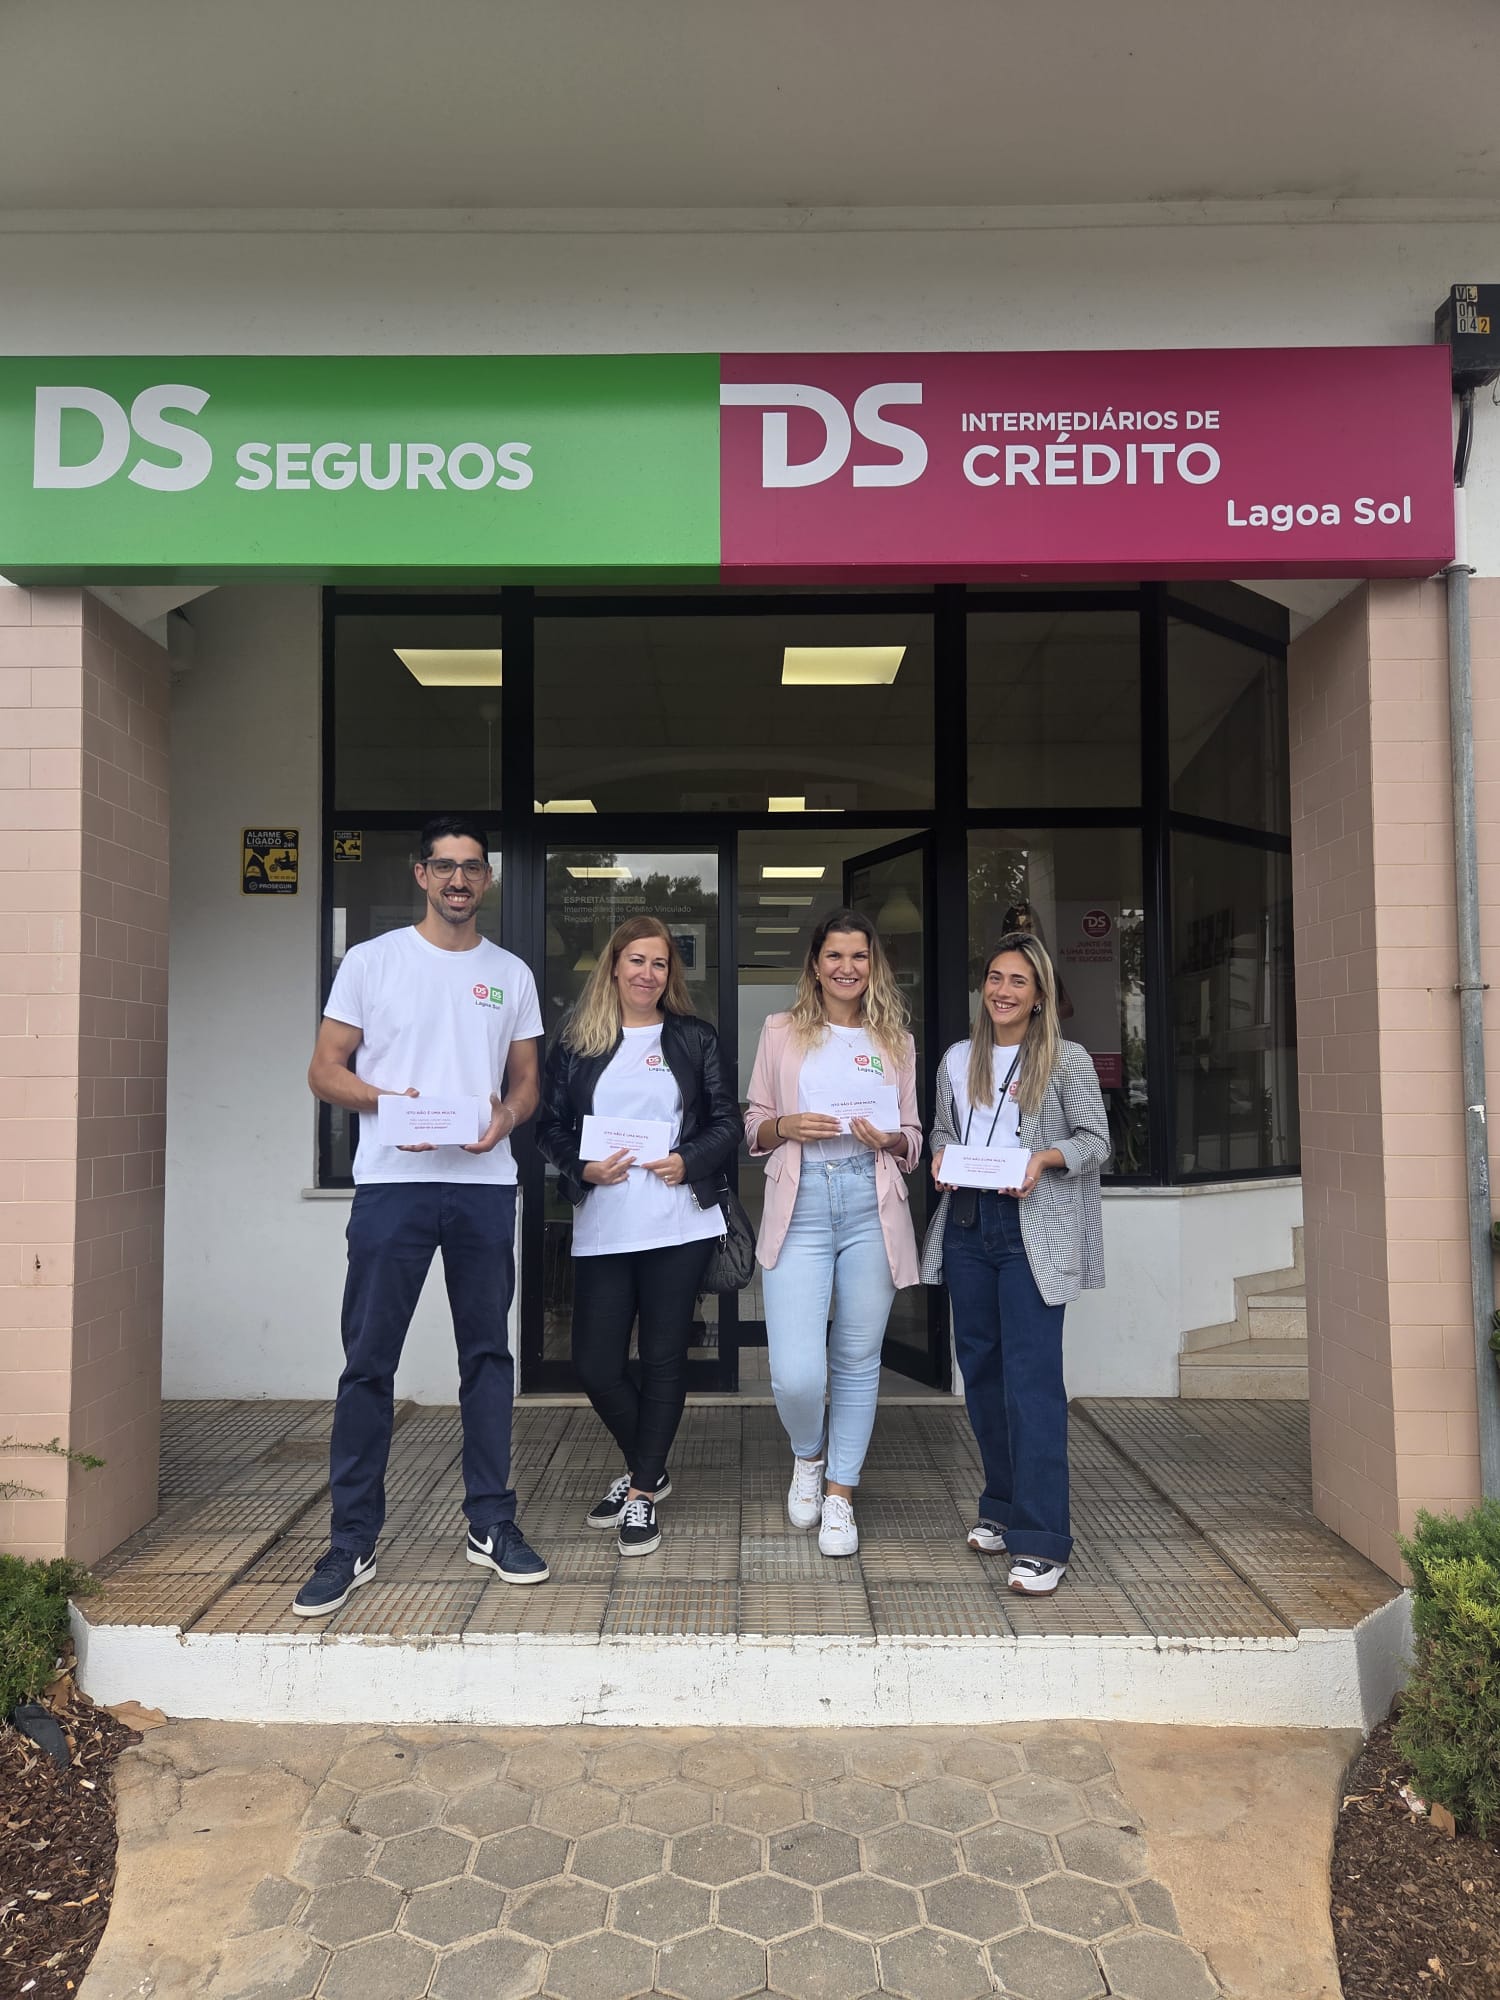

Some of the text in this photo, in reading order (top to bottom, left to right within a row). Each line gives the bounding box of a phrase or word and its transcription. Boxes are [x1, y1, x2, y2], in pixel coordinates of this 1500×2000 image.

[1459, 318, 1488, 333] 042
[961, 406, 1221, 432] INTERMEDIÁRIOS DE
[32, 383, 535, 493] DS SEGUROS
[720, 382, 929, 489] DS
[962, 432, 1221, 487] CRÉDITO
[1227, 496, 1412, 532] Lagoa Sol
[247, 831, 281, 839] ALARME
[626, 905, 653, 913] Crédito
[654, 905, 692, 913] Vinculado
[1083, 915, 1106, 928] DS
